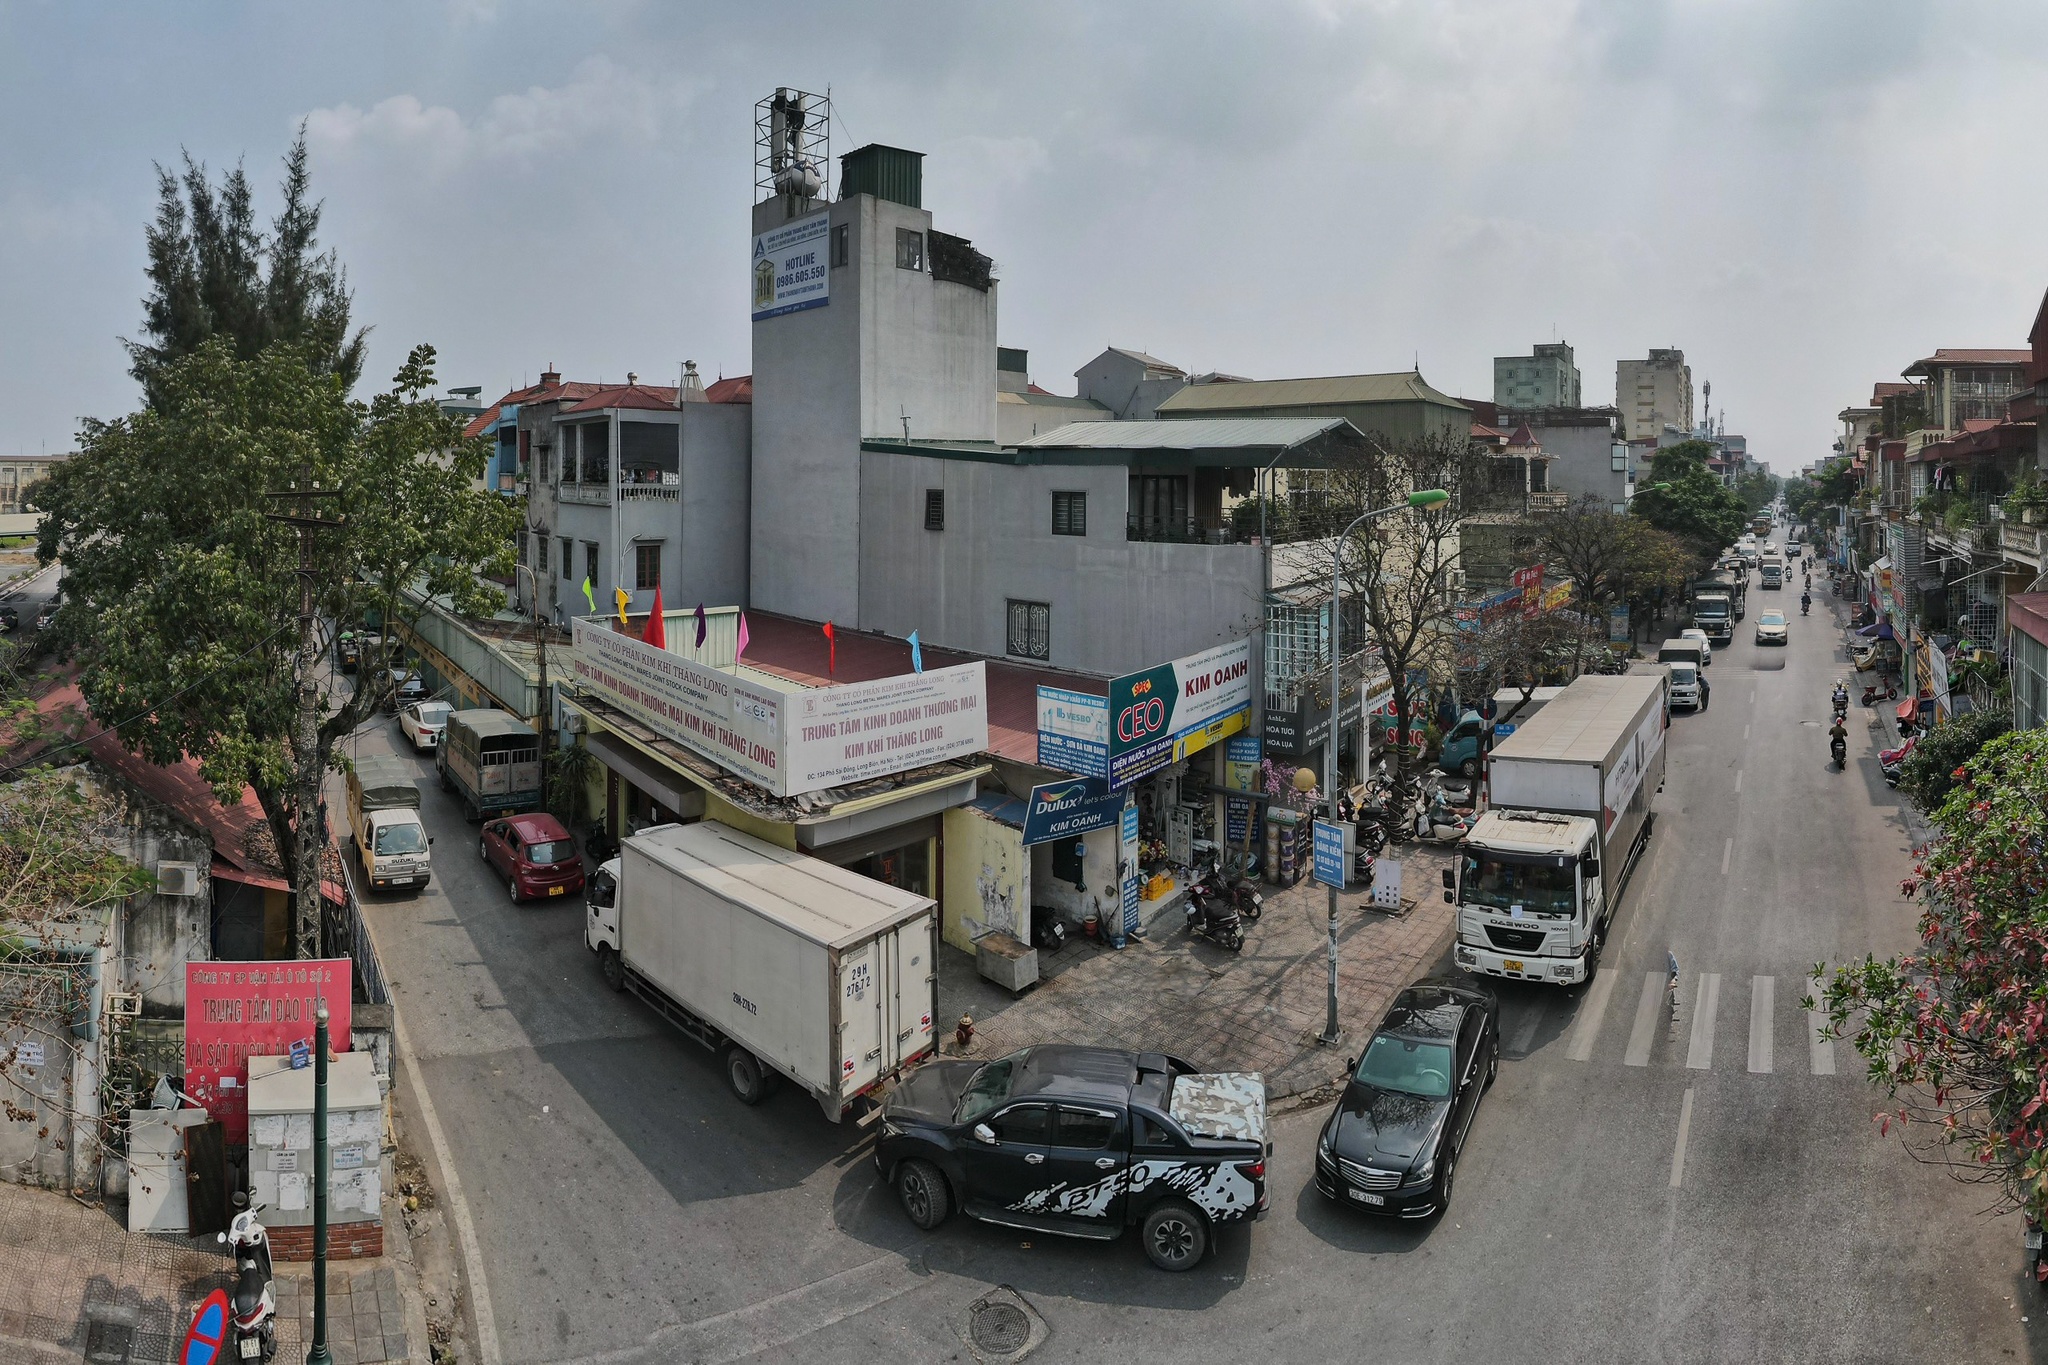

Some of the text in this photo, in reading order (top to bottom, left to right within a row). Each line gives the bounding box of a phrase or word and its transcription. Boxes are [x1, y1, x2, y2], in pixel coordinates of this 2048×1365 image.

[785, 252, 815, 271] HOTLINE
[776, 265, 825, 289] 0986.605.550
[586, 629, 602, 646] CÔNG
[603, 637, 612, 650] TY
[612, 636, 620, 654] CỔ
[622, 643, 641, 662] PHẦN
[641, 653, 656, 669] KIM
[657, 659, 672, 675] KHÍ
[703, 679, 728, 697] LONG
[622, 661, 635, 673] METAL
[636, 667, 652, 679] WARES
[652, 673, 665, 684] JOINT
[665, 679, 682, 691] STOCK
[682, 686, 709, 702] COMPANY
[822, 675, 945, 703] CÔNG TY CỔ PHẦN KIM KHÍ THĂNG LONG
[1134, 680, 1150, 695] SPEC
[1185, 659, 1248, 698] KIM OANH
[862, 696, 876, 705] METAL
[891, 691, 903, 699] JOINT
[903, 689, 916, 697] STOCK
[915, 686, 934, 695] COMPANY
[574, 660, 776, 770] TRUNG TÂM KINH DOANH THƯƠNG MẠI KIM KHÍ THĂNG LONG
[801, 722, 837, 742] TRUNG
[839, 718, 861, 736] TÂM
[863, 713, 887, 732] KINH
[889, 707, 921, 726] DOANH
[923, 698, 958, 719] THƯƠNG
[960, 695, 977, 712] MẠI
[1066, 712, 1091, 723] VESBO
[1117, 697, 1165, 743] CEO
[1209, 721, 1224, 734] VESBO
[1265, 725, 1295, 736] HOA TƯƠI
[844, 725, 943, 760] KIM KHÍ THĂNG LONG
[1083, 743, 1093, 753] KIM
[1093, 745, 1106, 756] OANH
[1112, 738, 1173, 771] ĐIỆN NƯỚC KIM OANH
[1266, 738, 1294, 749] HOA LỤA
[856, 761, 869, 772] Long
[1615, 754, 1630, 785] HITACHI
[1035, 790, 1124, 815] Dulux let's colour
[1049, 820, 1069, 833] KIM
[1071, 813, 1102, 828] OANH
[1490, 919, 1540, 930] DAEWOO
[191, 965, 332, 986] CÔNG TY CP VẬN TẢI Ô TÔ SỐ 2
[846, 976, 871, 998] 276.72
[246, 993, 272, 1023] TÂM
[275, 992, 300, 1023] ĐÀO
[188, 1038, 204, 1068] VÀ
[206, 1037, 230, 1068] SÁT
